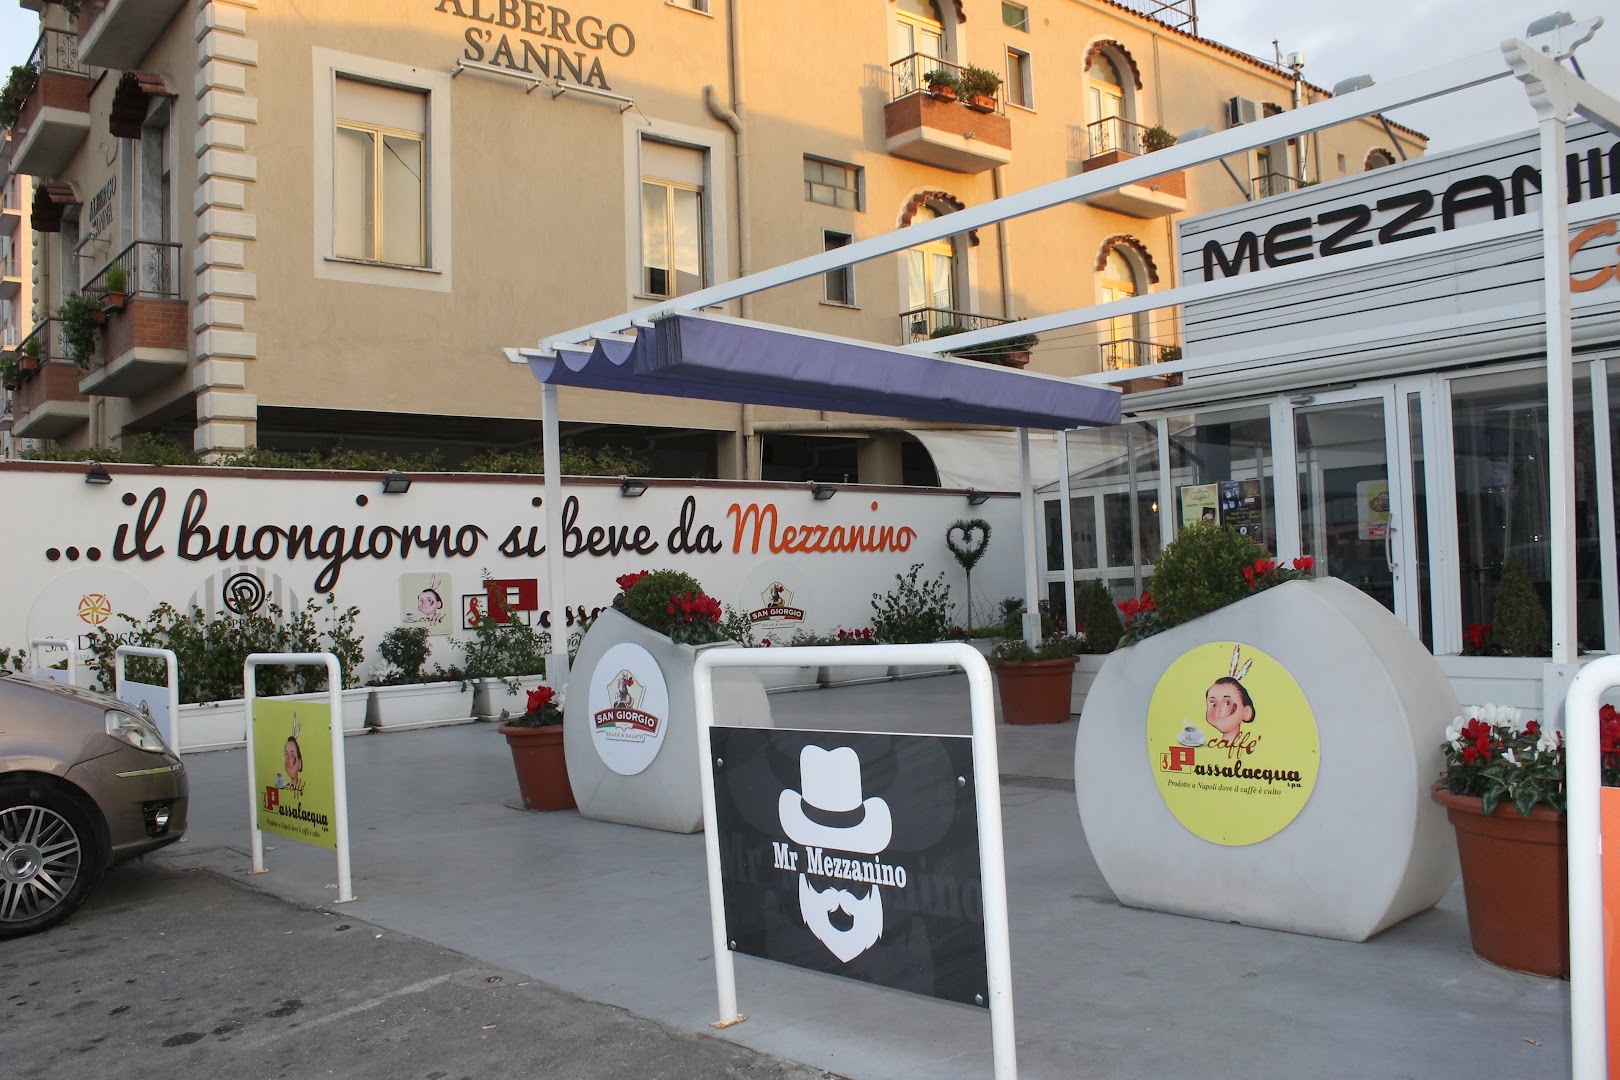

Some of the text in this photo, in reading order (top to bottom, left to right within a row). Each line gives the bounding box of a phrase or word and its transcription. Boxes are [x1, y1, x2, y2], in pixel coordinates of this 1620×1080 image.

[434, 0, 636, 57] ALBERGO
[463, 26, 612, 91] S'ANNA
[1202, 141, 1620, 283] MEZZANI
[177, 488, 490, 594] buongiorno
[498, 496, 546, 558] si
[561, 495, 659, 557] beve
[667, 495, 723, 554] da
[726, 500, 918, 555] Mezzanino
[752, 608, 801, 619] SAN GIORGIO
[597, 711, 655, 727] SAN GIORGIO
[1167, 779, 1191, 789] Prodotto
[1197, 782, 1217, 791] Napoli
[1218, 784, 1233, 792] dove
[1234, 785, 1239, 793] il
[1263, 788, 1282, 796] culto
[1168, 745, 1303, 785] Passalacqua
[772, 841, 798, 872] Mr
[806, 846, 907, 888] Mezzanino
